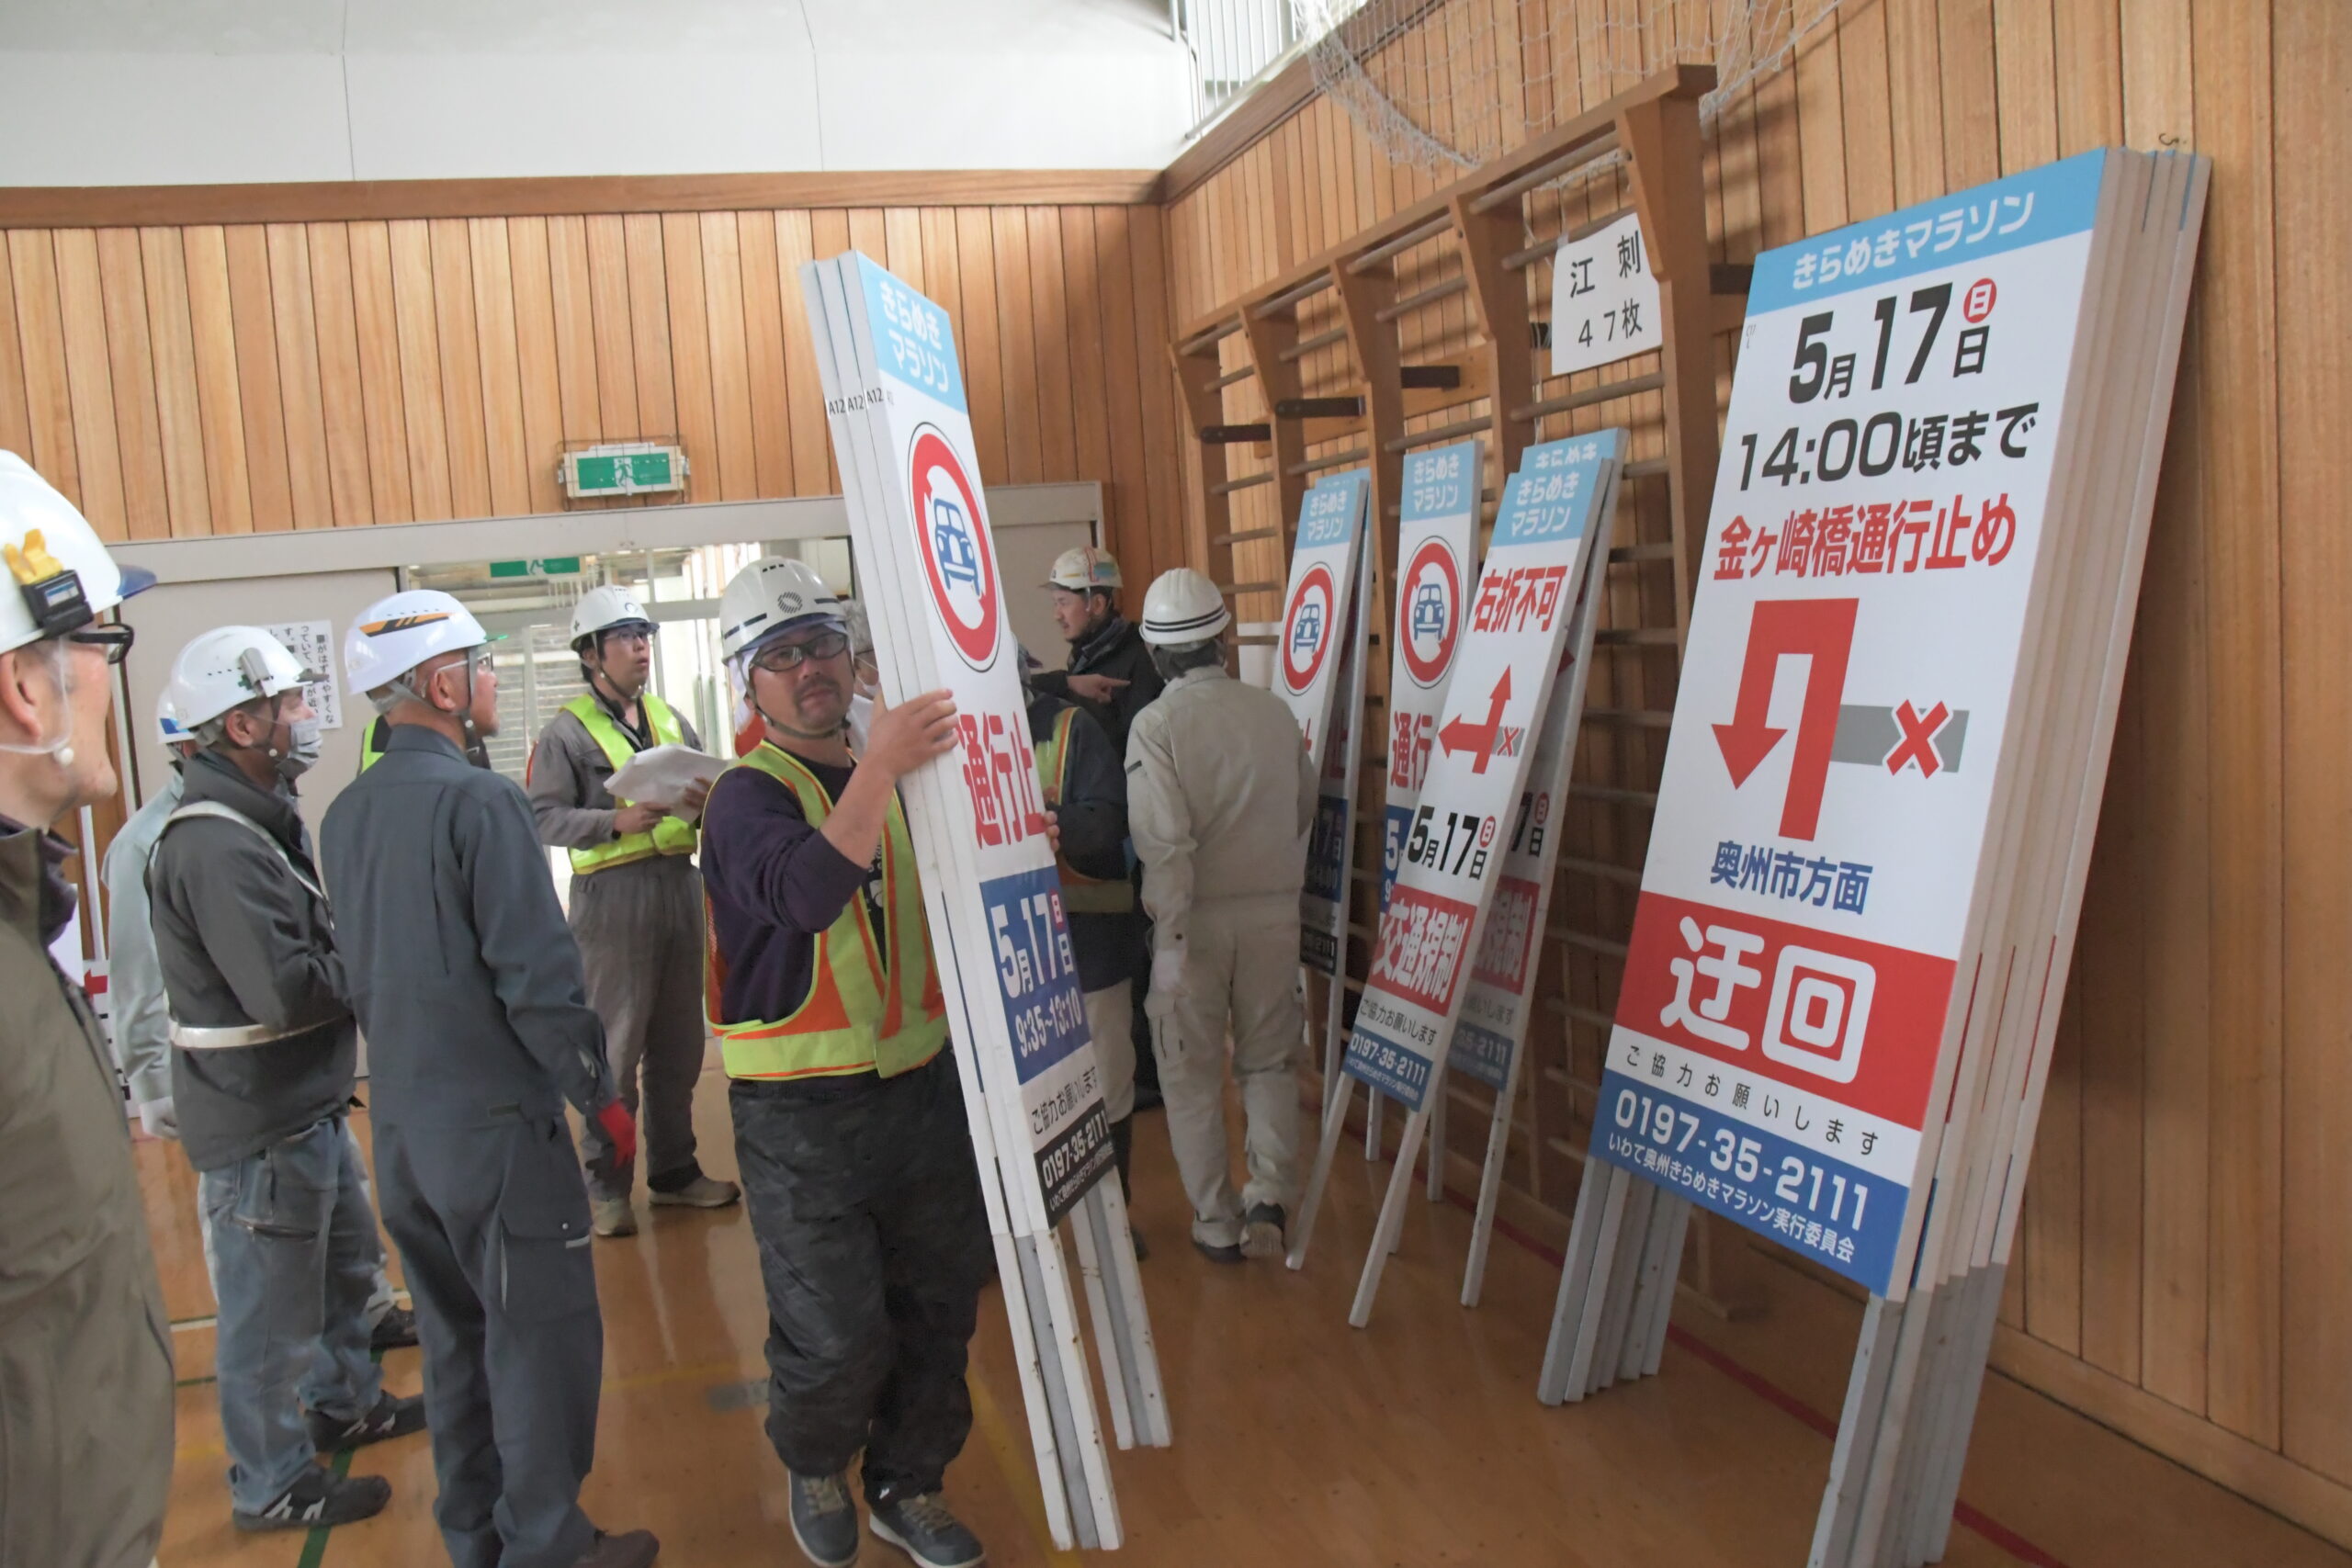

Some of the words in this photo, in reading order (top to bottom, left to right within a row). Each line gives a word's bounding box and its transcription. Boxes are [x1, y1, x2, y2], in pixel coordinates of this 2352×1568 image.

[1569, 230, 1642, 299] 江刺
[1792, 191, 2035, 291] きらめきマラソン
[879, 280, 943, 351] きらめき
[1577, 297, 1644, 348] 47枚
[866, 387, 884, 404] A12
[888, 328, 950, 394] マラソン
[829, 398, 846, 416] A12
[847, 395, 865, 412] A12
[1413, 453, 1461, 485] きらめき
[1738, 400, 2040, 492] 14:00頃まで
[1413, 484, 1459, 513] マラソン
[1510, 506, 1572, 537] マラソン
[1517, 471, 1581, 505] きらめき
[1473, 565, 1569, 634] 右折不可
[316, 634, 334, 725] がはずやすくな
[956, 710, 1046, 851] 通行止
[1709, 840, 1874, 916] 奥州市方面
[1372, 897, 1469, 1005] 交通規制
[1358, 998, 1439, 1046] ご協力お願いします
[1658, 915, 1878, 1085] 迂回
[1349, 1032, 1426, 1087] 0197-35-2111
[1624, 1043, 1880, 1156] ご協力お願いします
[1042, 1110, 1111, 1190] 0197-35-2111
[1613, 1088, 1870, 1231] 0197-35-2111
[1608, 1133, 1856, 1265] いわて奥州きらめきマラソン実行委員会
